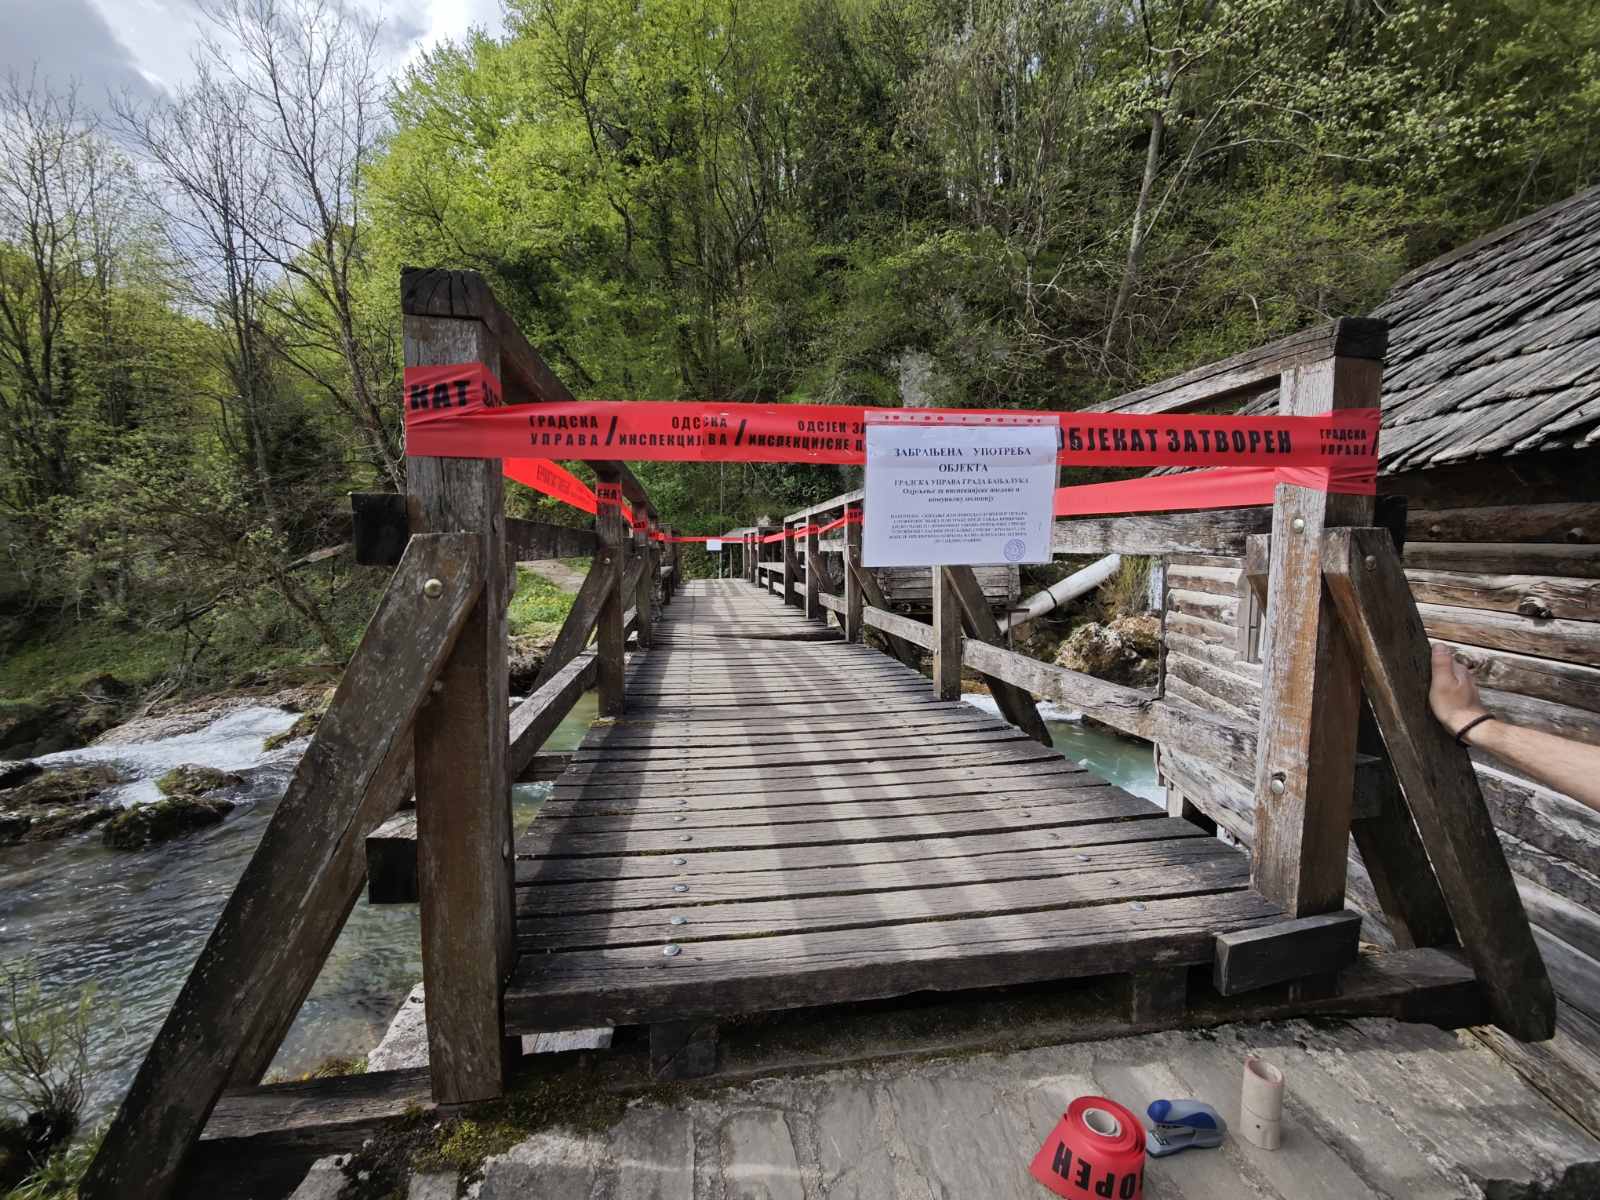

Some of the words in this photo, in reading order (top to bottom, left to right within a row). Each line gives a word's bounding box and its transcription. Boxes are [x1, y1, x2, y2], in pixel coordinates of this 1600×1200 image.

[410, 379, 471, 410] КАТ
[528, 415, 599, 430] ГРАДСКА
[797, 420, 846, 433] ОДСЈЕК
[530, 432, 599, 446] УПРАВА
[1319, 428, 1367, 441] ГРАДСКА
[748, 434, 850, 451] ИНСПЕКЦИЈСКЕ
[1167, 429, 1292, 454] ЗАТВОРЕН
[895, 447, 963, 457] ЗАБРАЊЕНА
[972, 446, 1032, 456] УПОТРЕБА
[1320, 444, 1367, 456] УПРАВА
[938, 463, 989, 473] ОБЈЕКТА
